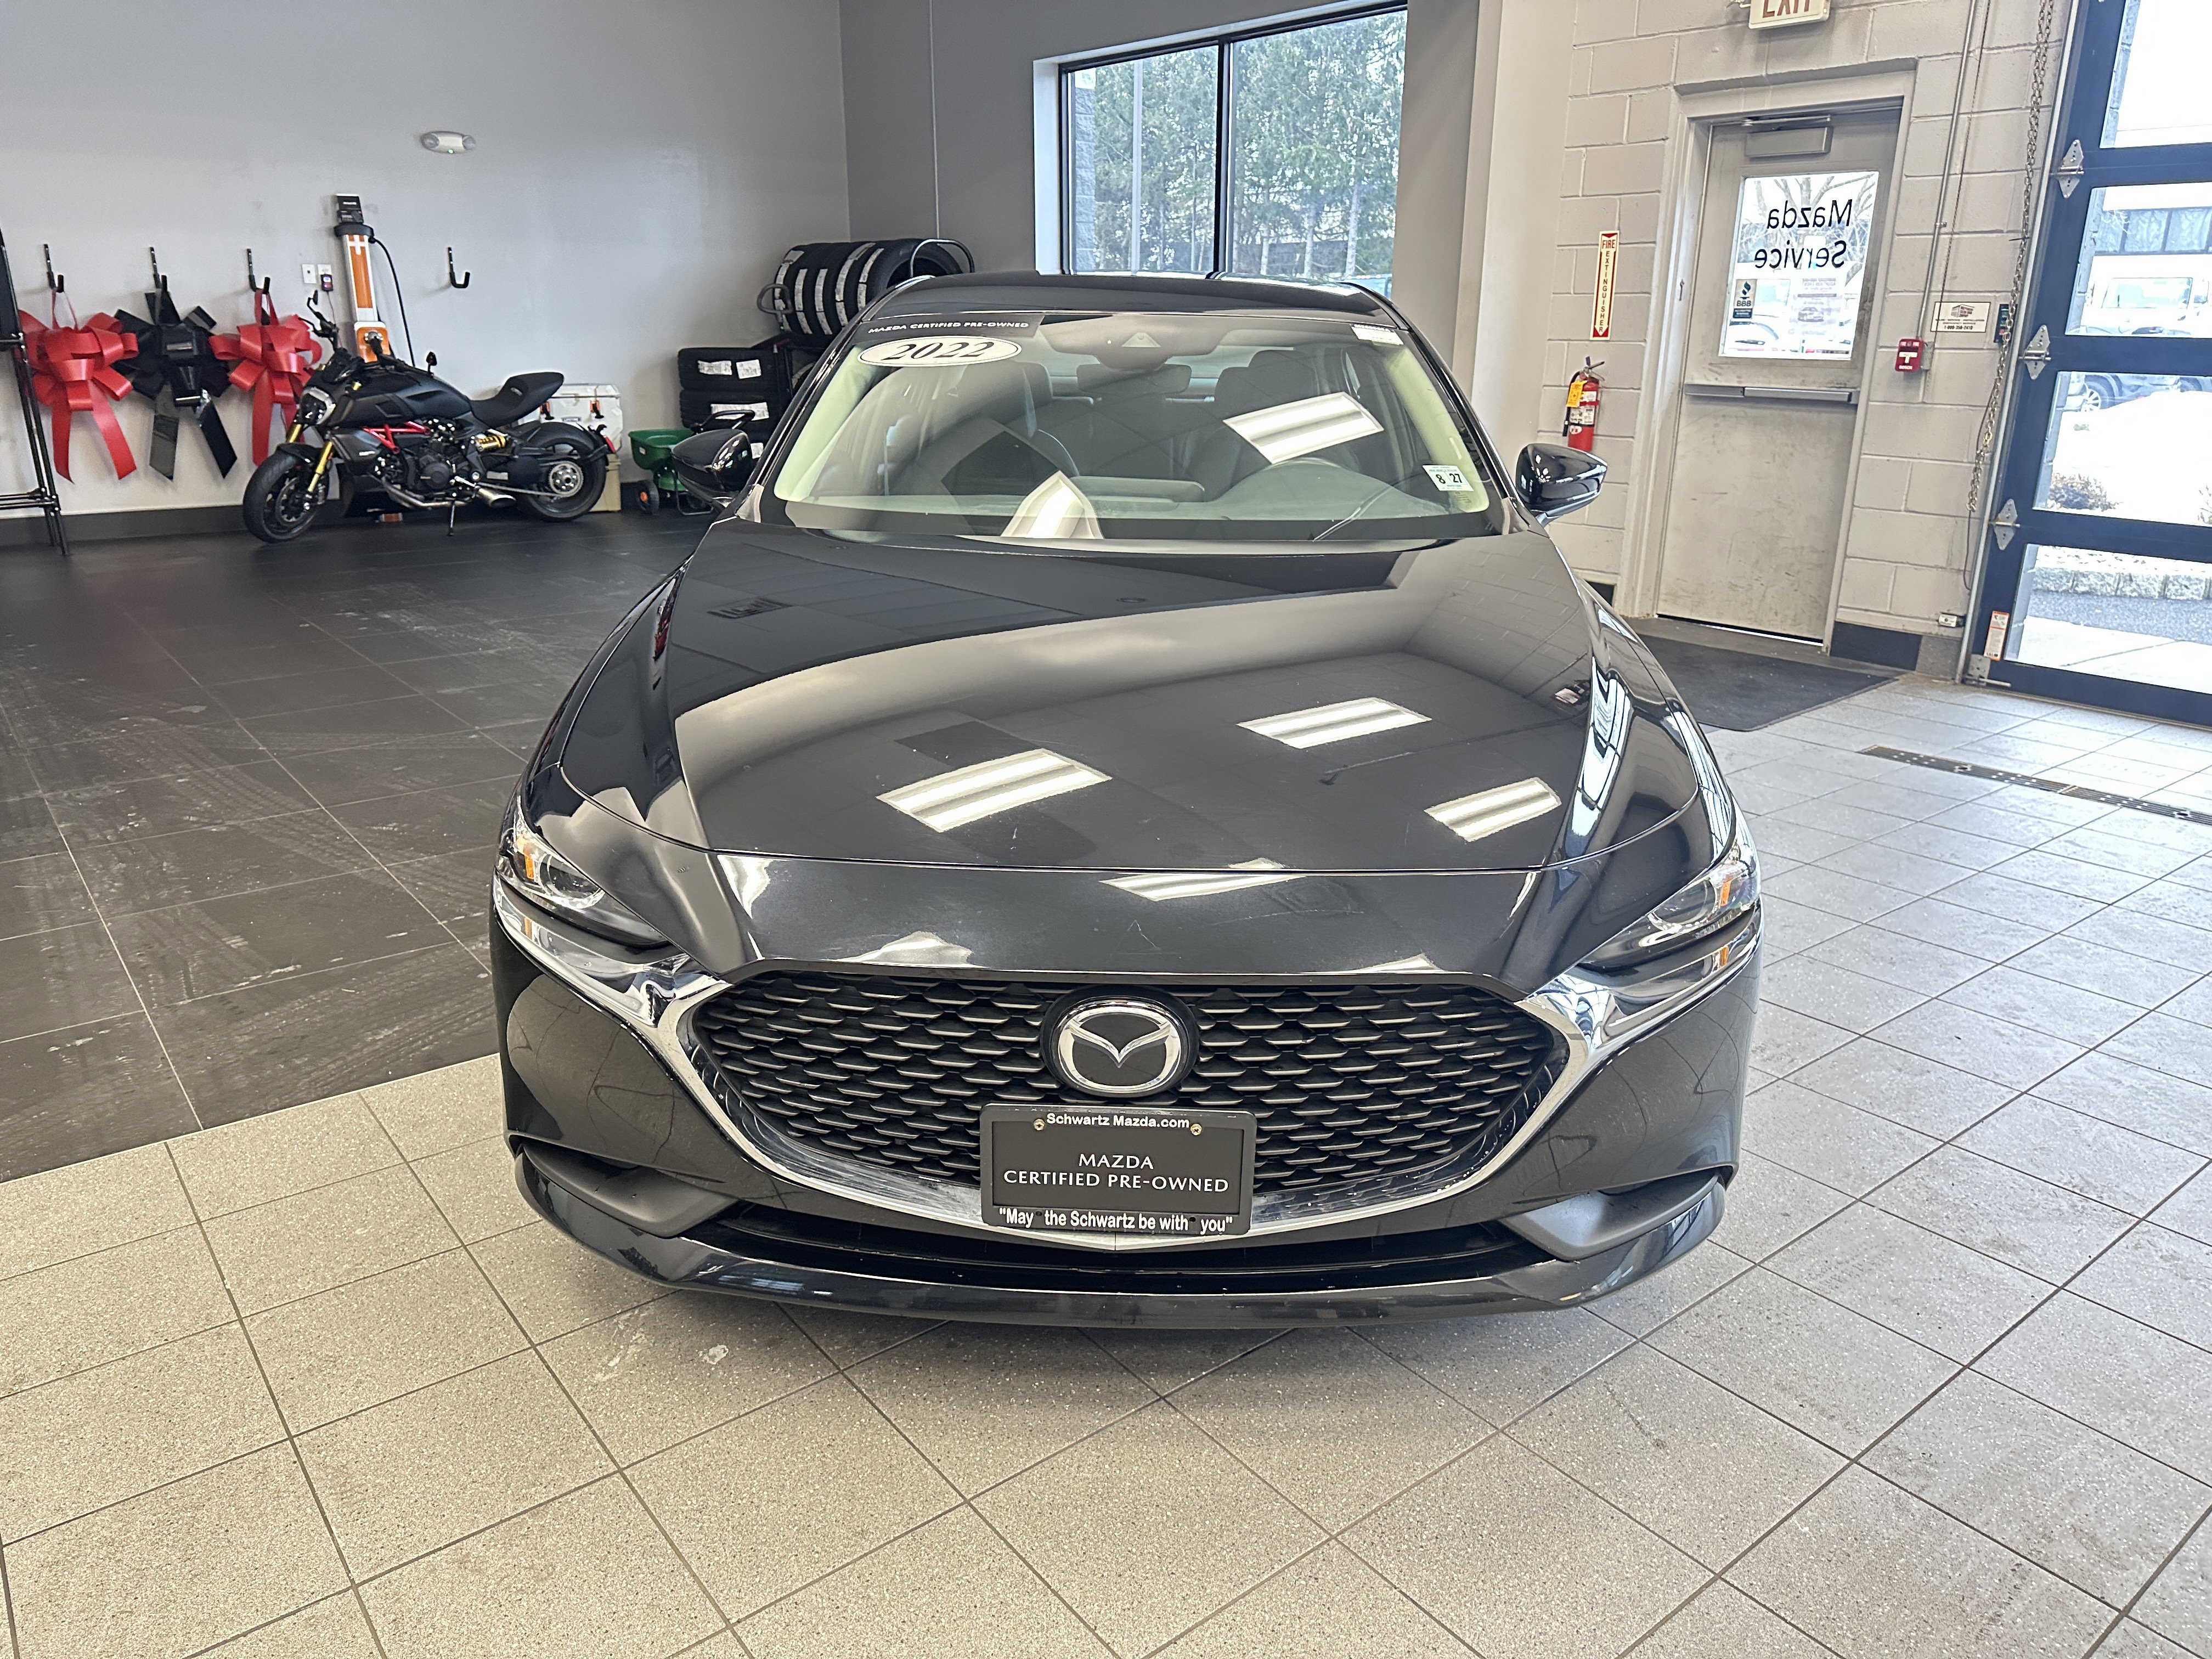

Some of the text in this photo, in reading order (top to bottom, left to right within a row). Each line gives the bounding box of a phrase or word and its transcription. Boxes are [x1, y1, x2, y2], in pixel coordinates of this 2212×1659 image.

[1601, 239, 1616, 249] FIRE
[1599, 250, 1610, 332] EXTINGUISHER
[868, 325, 907, 334] MAZDA
[881, 341, 995, 361] 2022
[1436, 473, 1463, 484] 8 27
[1046, 1113, 1190, 1128] Schwartz Mazda.com
[1078, 1153, 1154, 1170] MAZDA
[1003, 1170, 1229, 1192] CERTIFIED PRE-OWNED
[999, 1207, 1233, 1235] "May the Schwartz be with you"
